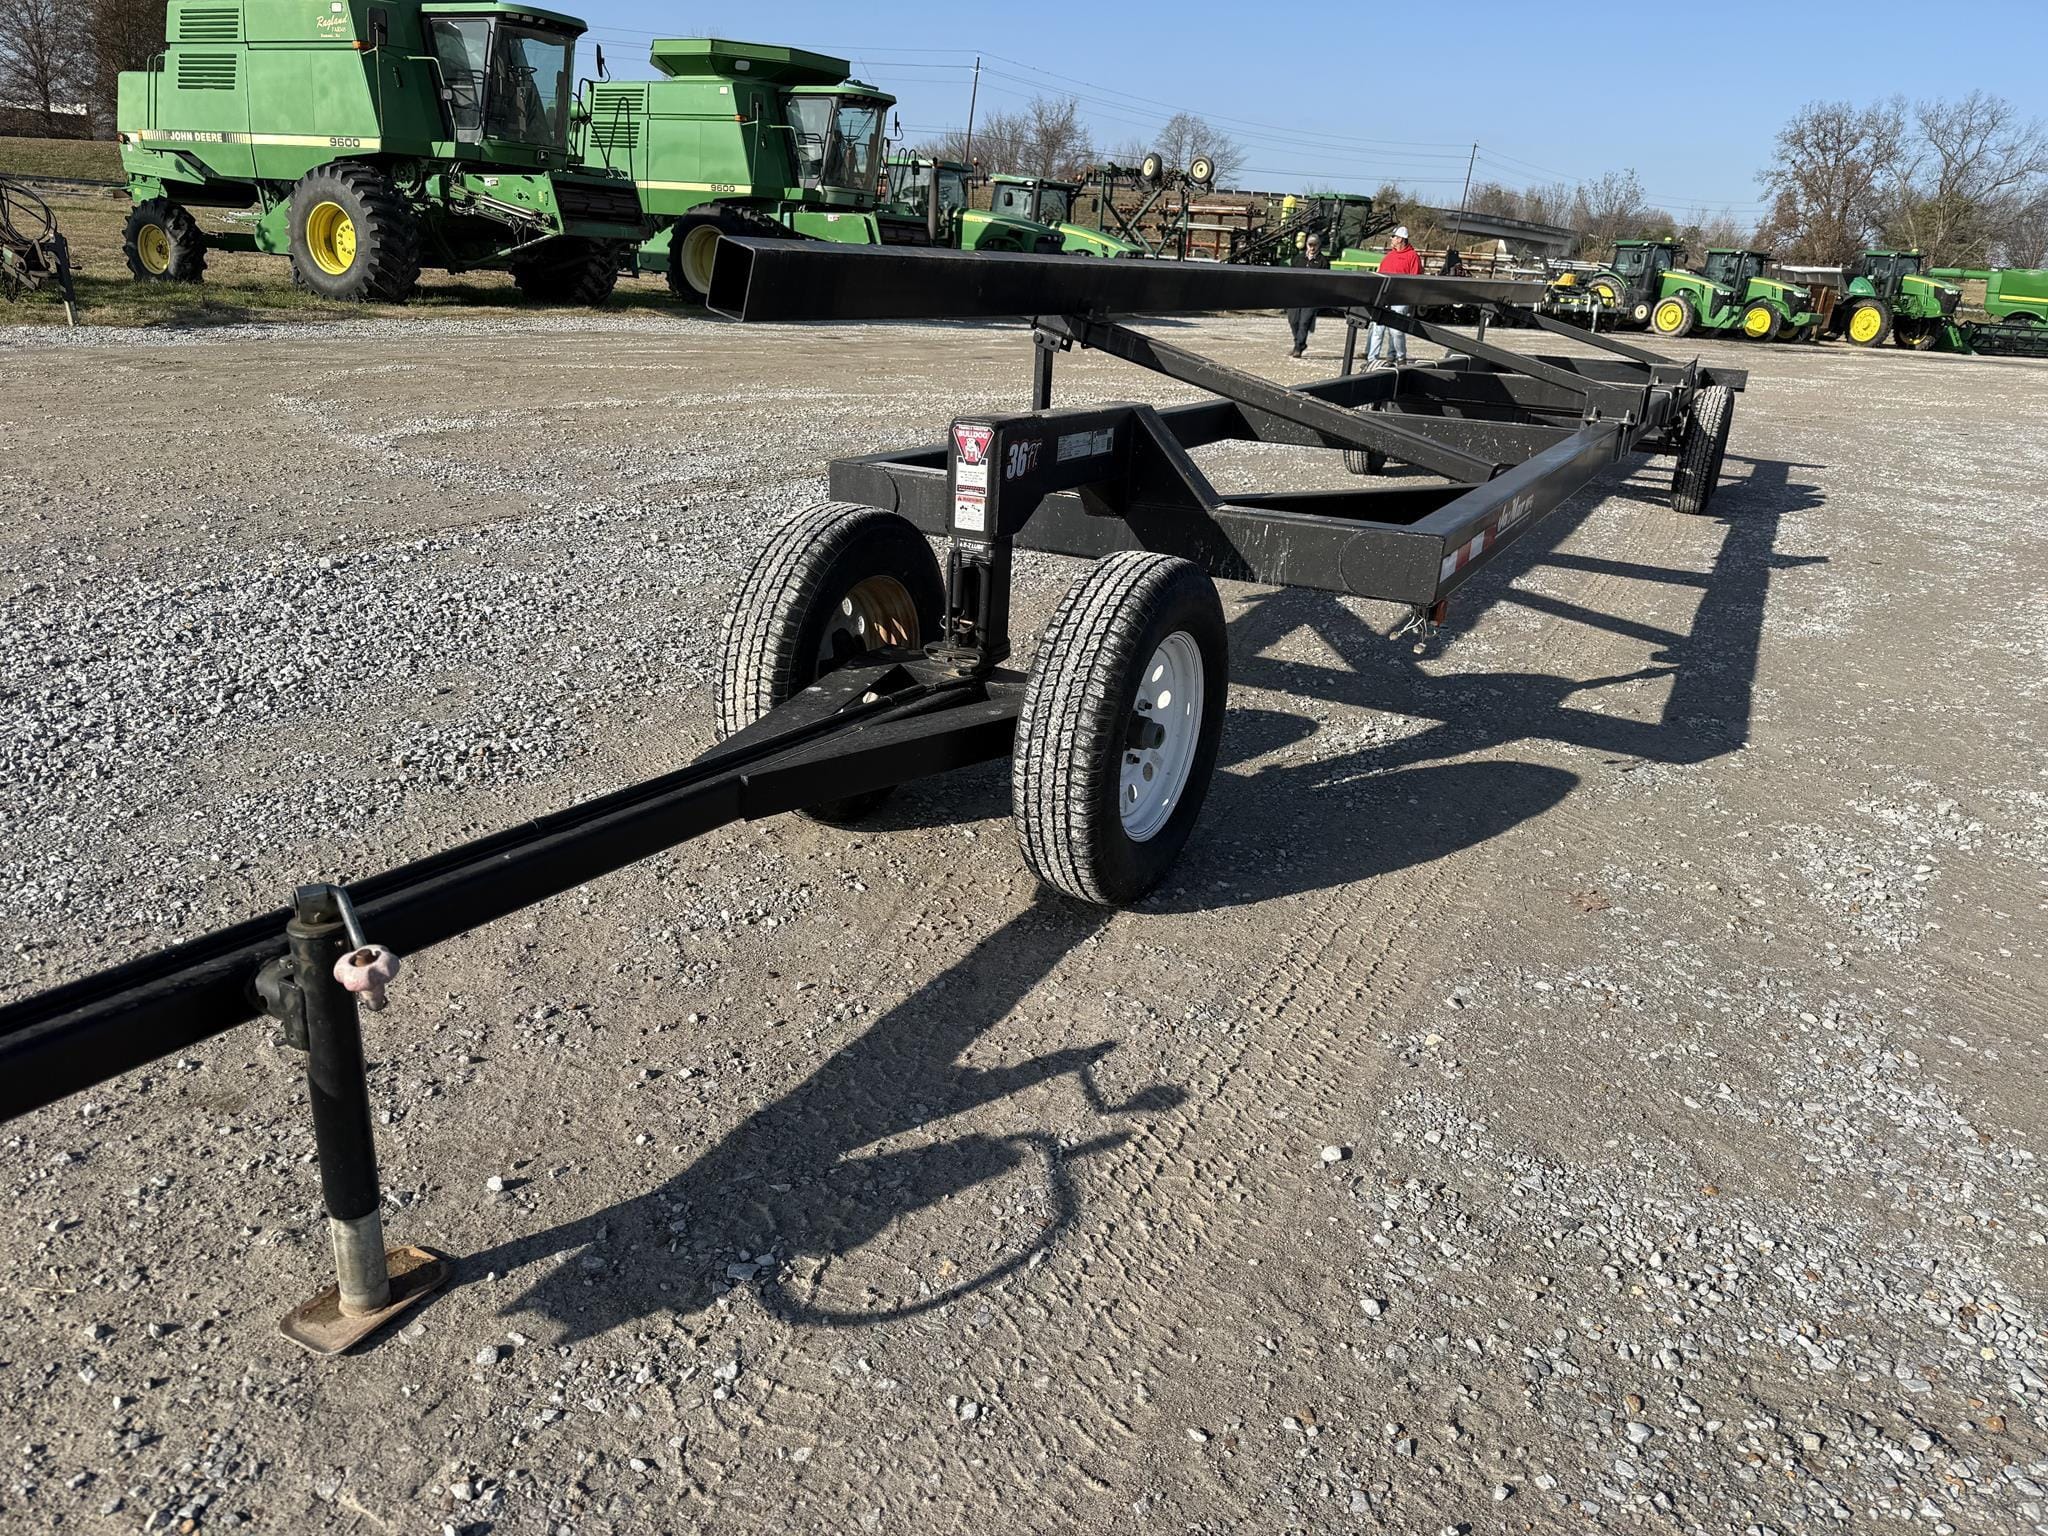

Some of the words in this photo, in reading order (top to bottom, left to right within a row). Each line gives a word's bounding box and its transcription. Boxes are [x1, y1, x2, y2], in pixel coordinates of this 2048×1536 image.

[316, 13, 349, 30] Ragland
[170, 130, 193, 142] JOHN
[194, 132, 223, 143] DEERE
[330, 137, 361, 148] 9600
[711, 184, 736, 192] 9600
[958, 430, 988, 438] BULLDOG
